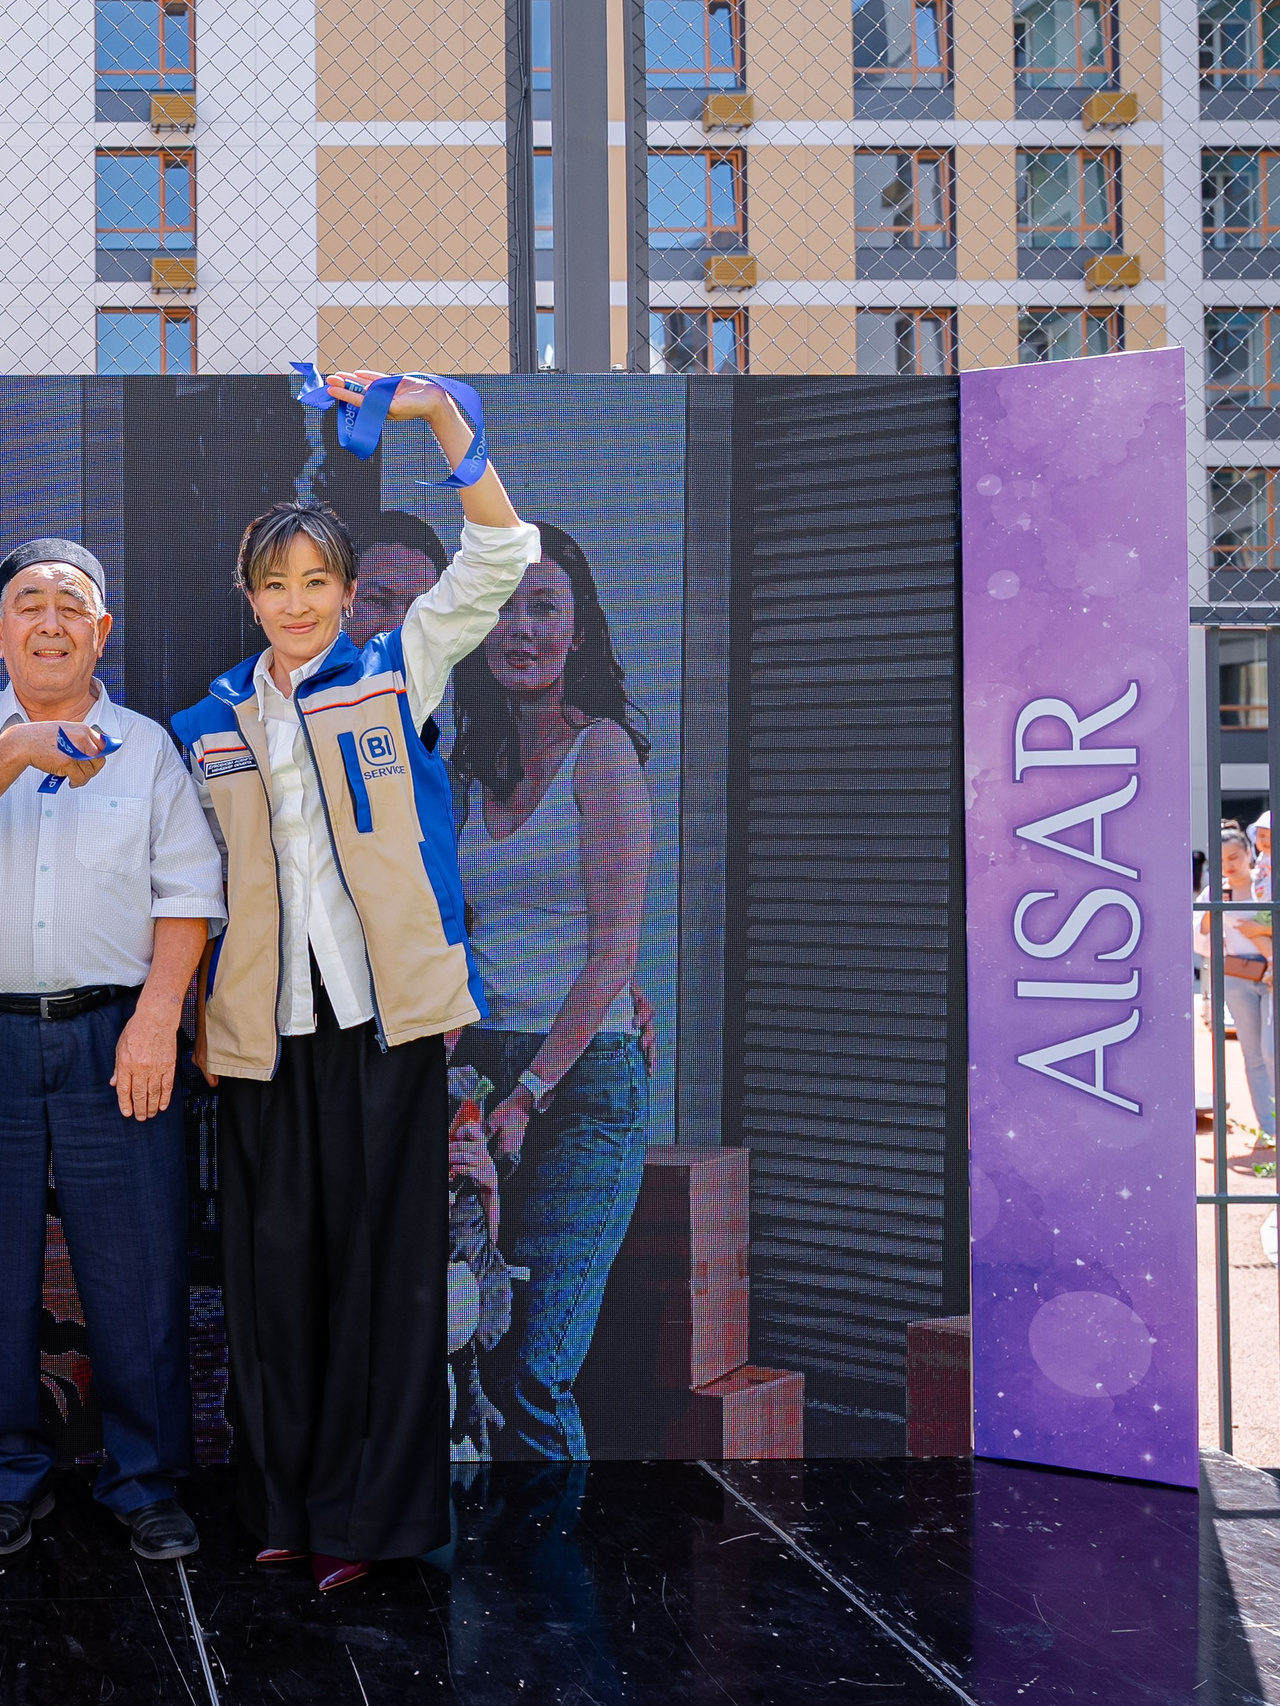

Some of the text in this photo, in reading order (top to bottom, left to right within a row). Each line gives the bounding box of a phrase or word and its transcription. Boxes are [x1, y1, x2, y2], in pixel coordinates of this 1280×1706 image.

[366, 734, 393, 759] BI
[363, 765, 406, 780] SERVICE
[1013, 679, 1142, 1115] AISAR
